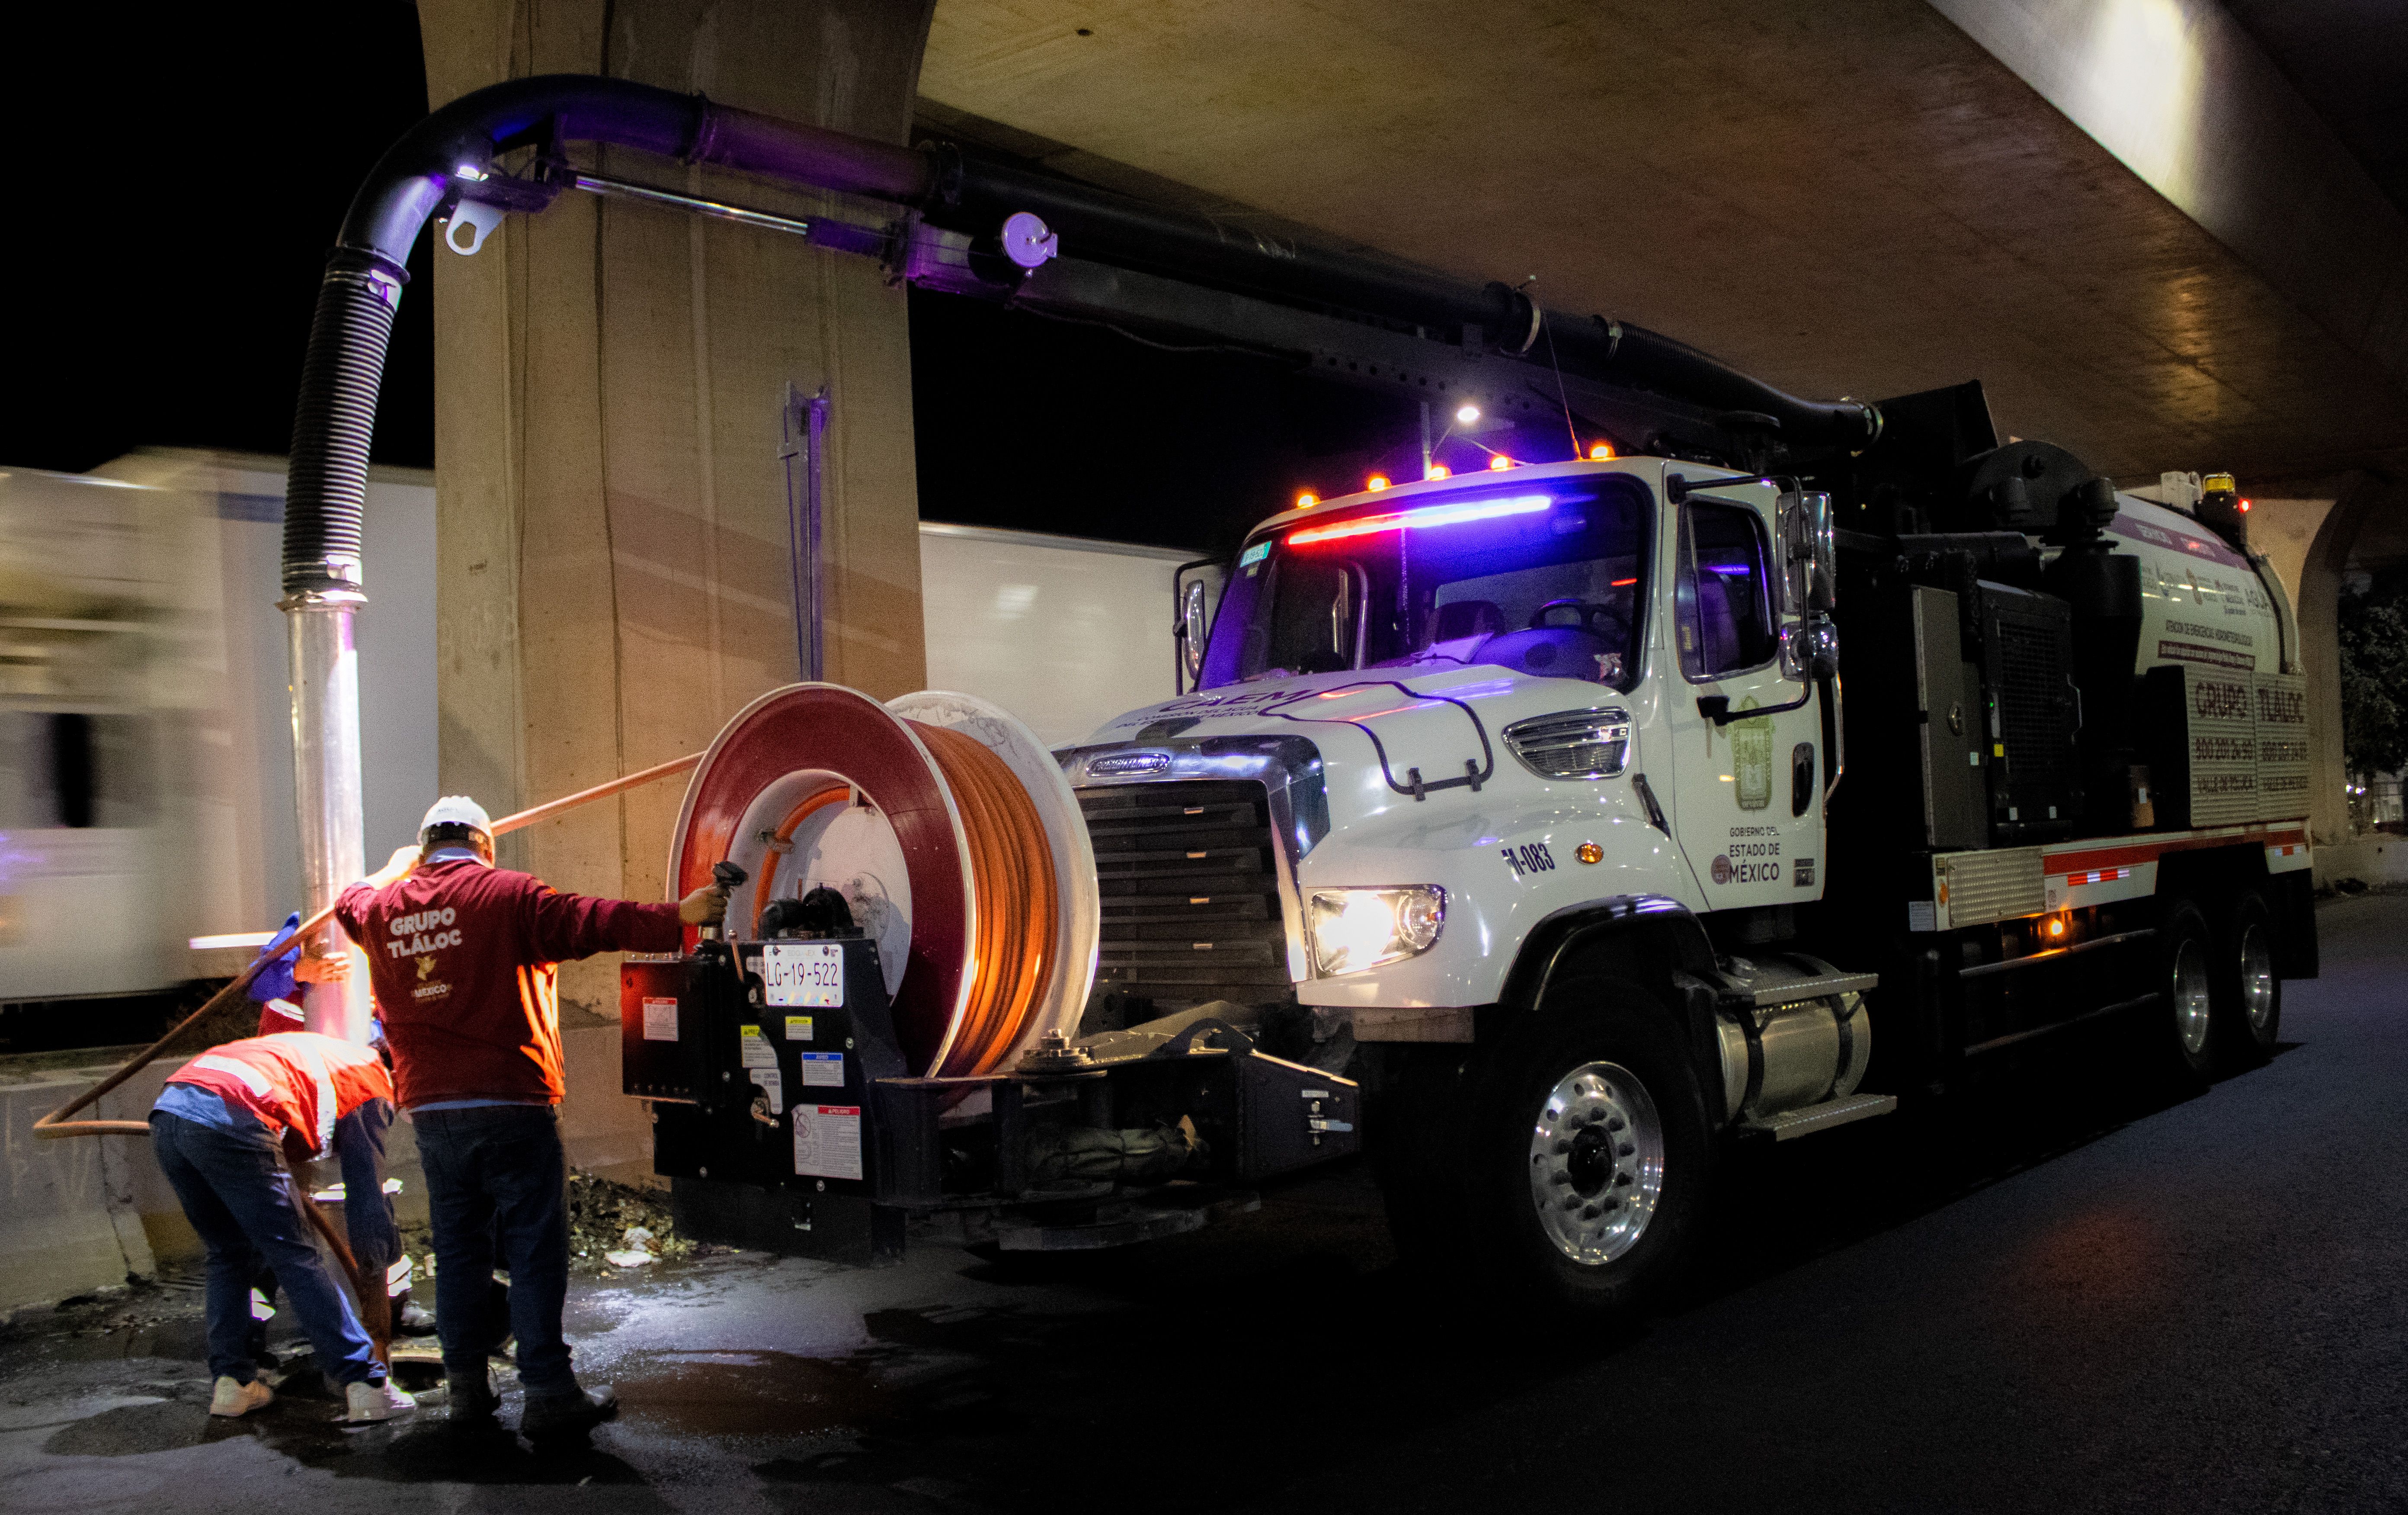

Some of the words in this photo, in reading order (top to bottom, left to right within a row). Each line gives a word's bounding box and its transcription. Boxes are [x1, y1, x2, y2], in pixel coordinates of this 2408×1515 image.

[1159, 689, 1314, 712] CAEM
[1730, 826, 1765, 837] GOBIERNO
[1766, 826, 1780, 836] DEL
[1729, 844, 1765, 857] ESTADO
[1768, 843, 1780, 856] DE
[1729, 859, 1780, 883] MÉXICO
[390, 907, 456, 936] GRUPO
[387, 929, 463, 959] TLÁLOC
[766, 962, 838, 987] LG-19-522
